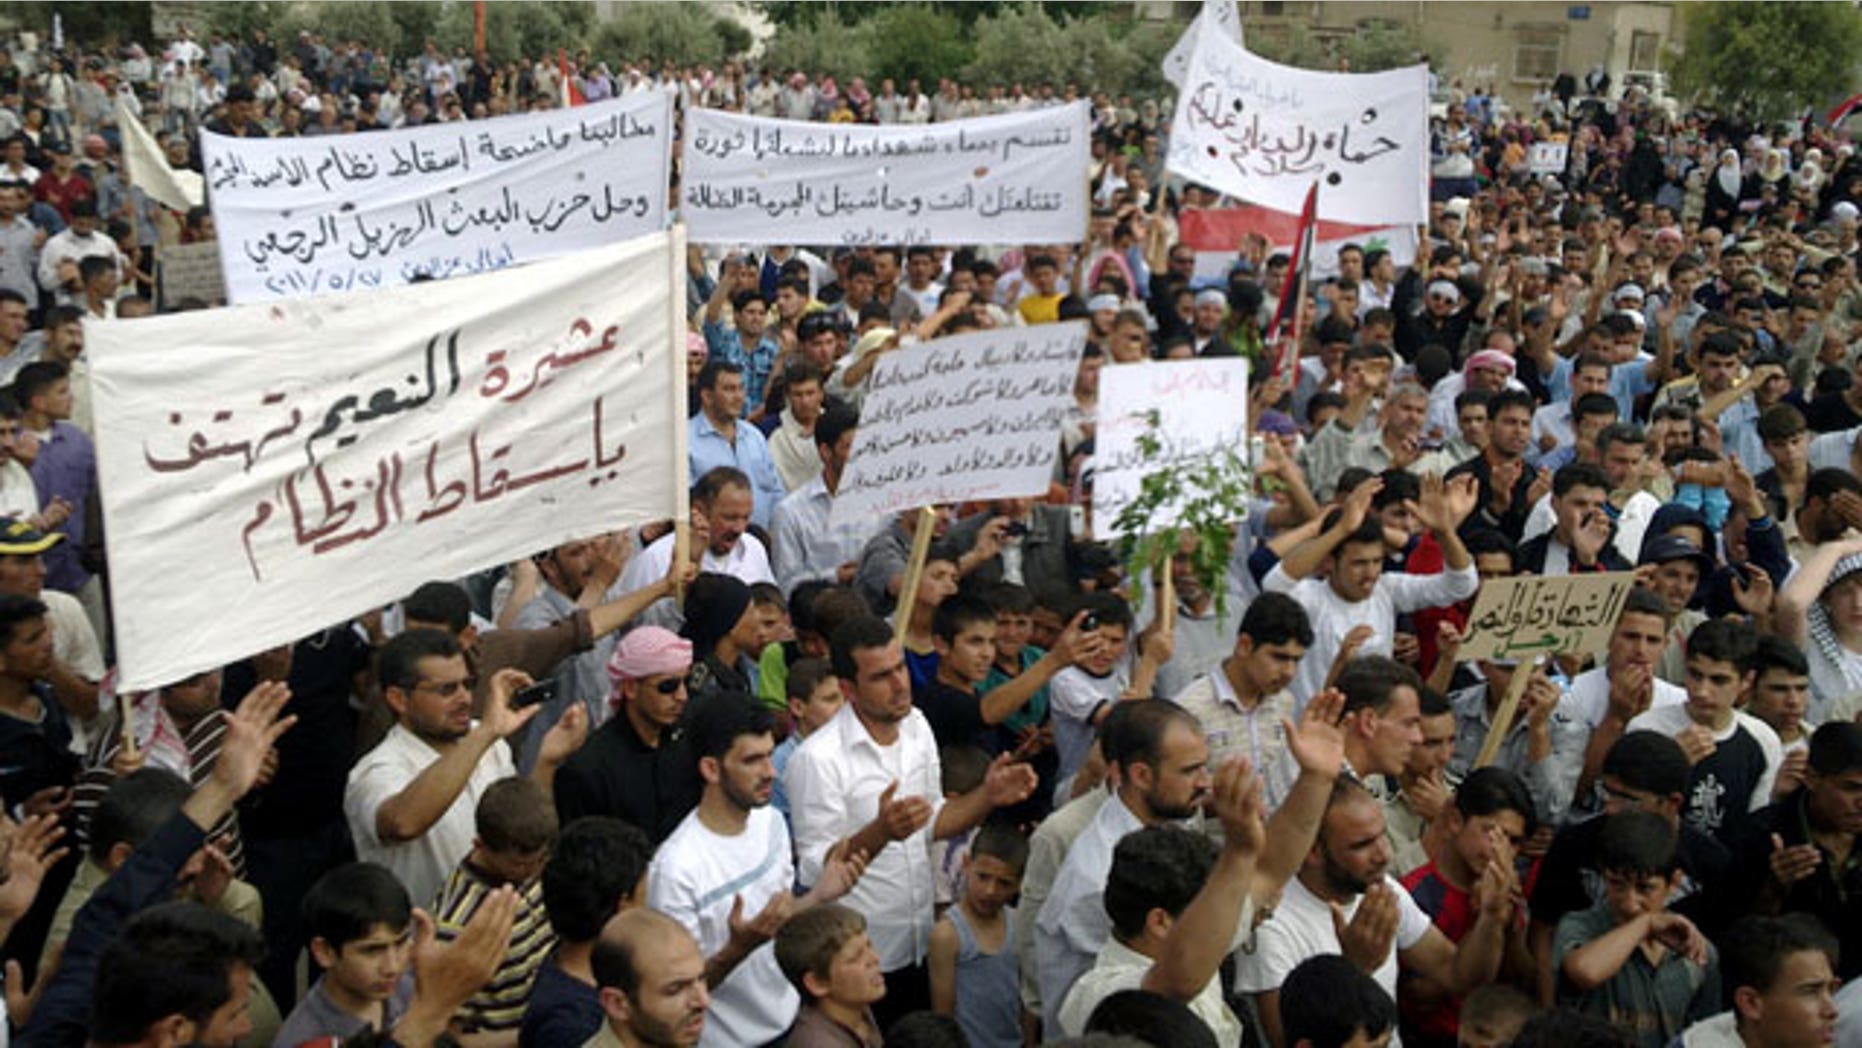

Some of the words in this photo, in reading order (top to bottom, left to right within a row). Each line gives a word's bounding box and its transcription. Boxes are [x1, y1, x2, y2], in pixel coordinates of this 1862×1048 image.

[695, 126, 746, 158] ثورة
[1003, 127, 1072, 161] نقسم
[317, 146, 379, 192] نظام
[442, 186, 519, 236] البعث
[590, 184, 650, 223] وحل
[479, 317, 619, 403] عشيرة
[301, 328, 462, 474] النعيم
[143, 392, 302, 474] تهتف
[242, 451, 403, 583] النظام
